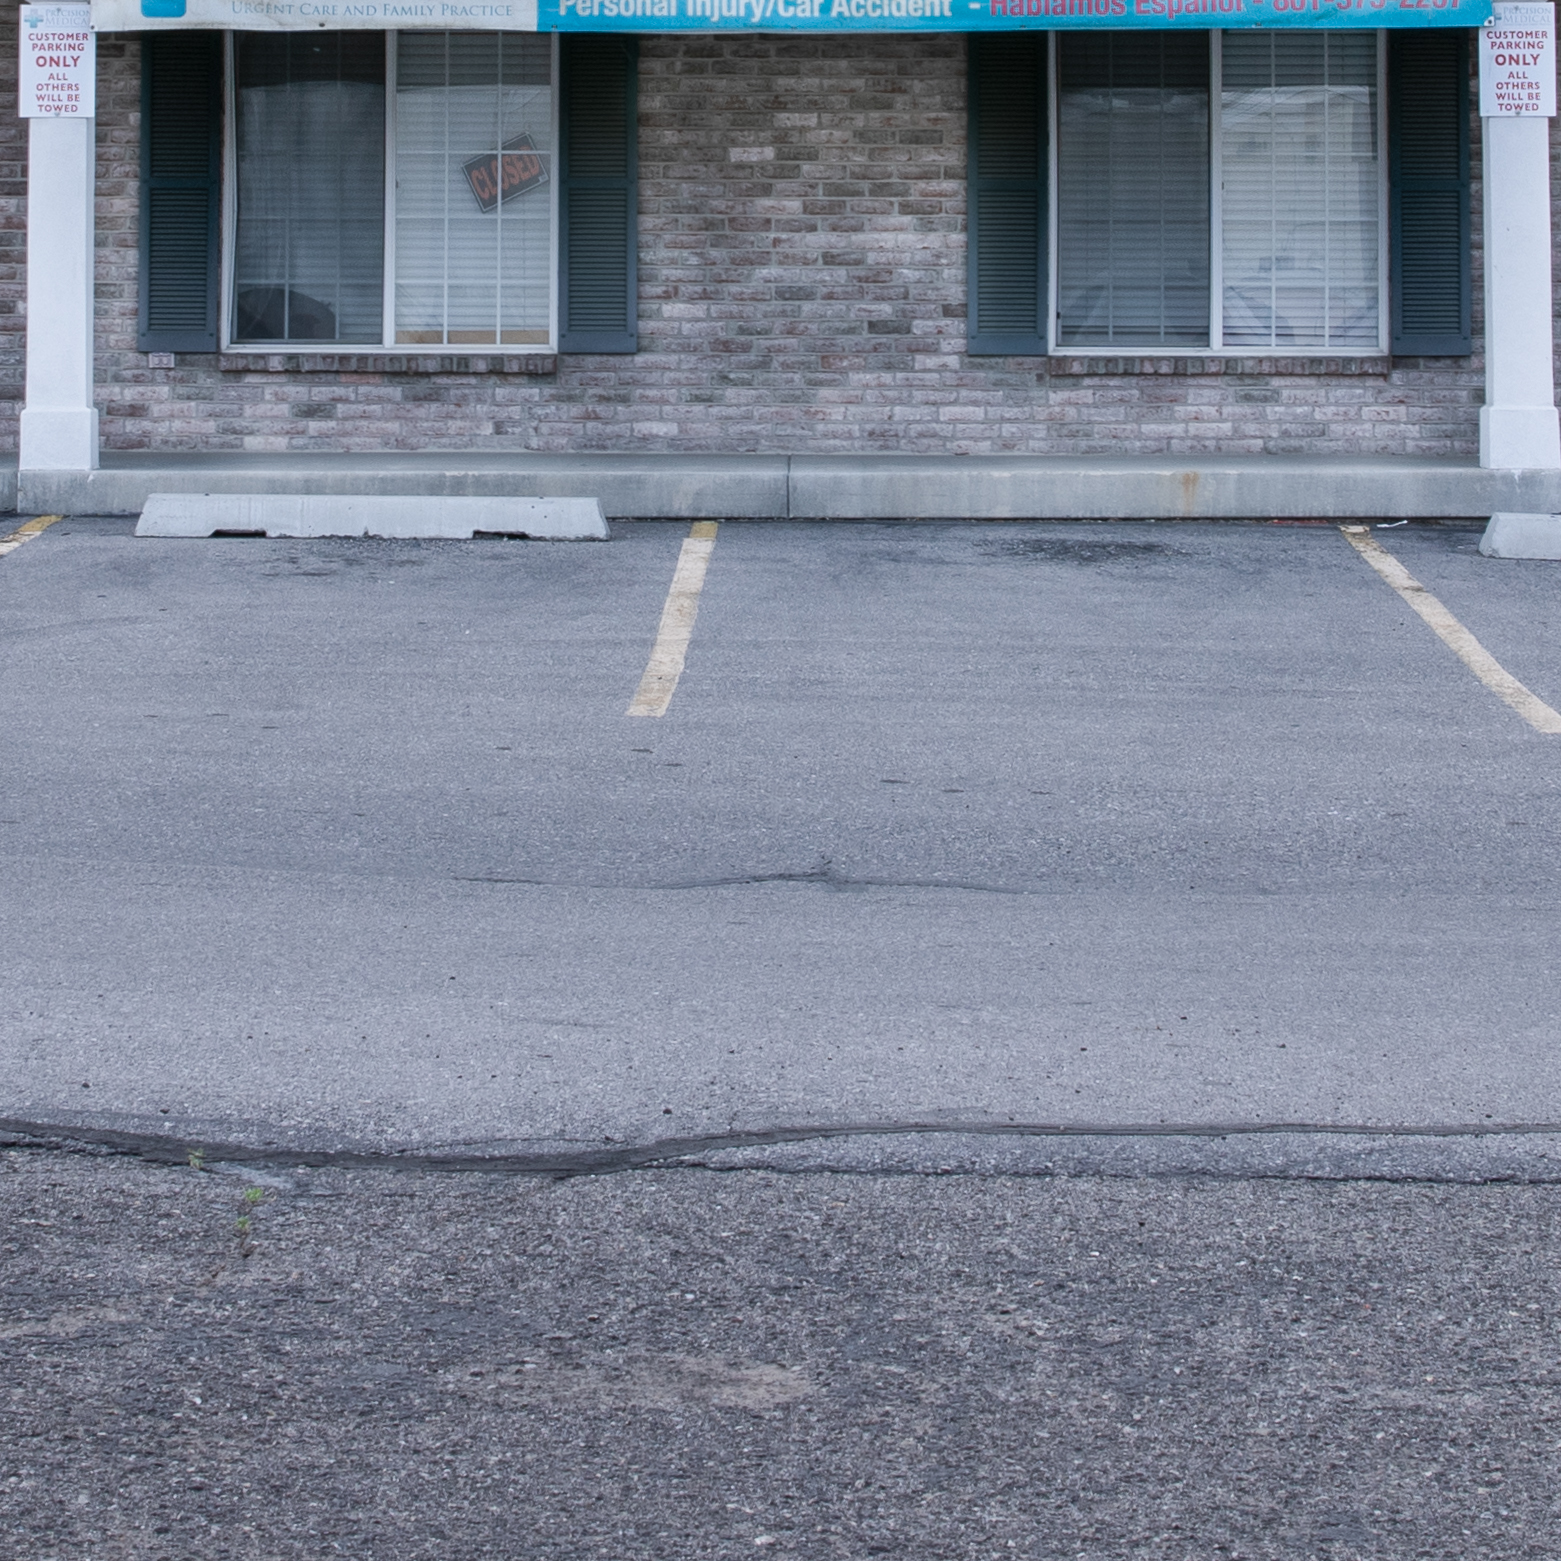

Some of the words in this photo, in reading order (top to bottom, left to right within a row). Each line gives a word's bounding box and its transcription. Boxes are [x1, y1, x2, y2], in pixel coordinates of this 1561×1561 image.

[232, 1, 295, 15] URGENT
[299, 3, 339, 16] CARE
[343, 4, 377, 16] AND
[383, 3, 436, 16] FAMILY
[441, 3, 513, 17] PRACTICE
[45, 17, 89, 25] MEDICA
[29, 33, 89, 41] CUSTOMER
[1487, 31, 1548, 39] CUSTOMER
[32, 43, 85, 51] PARKING
[1491, 41, 1544, 49] PARKING
[36, 55, 80, 67] ONLY
[1495, 54, 1540, 66] ONLY
[1508, 71, 1528, 79] ALL
[36, 83, 80, 91] OTHERS
[1496, 82, 1540, 90] OTHERS
[36, 94, 63, 102] WILL
[67, 94, 80, 102] BE
[1496, 92, 1523, 100] WILL
[1527, 92, 1541, 100] BE
[38, 104, 78, 112] TOWED
[1498, 103, 1539, 111] TOWED
